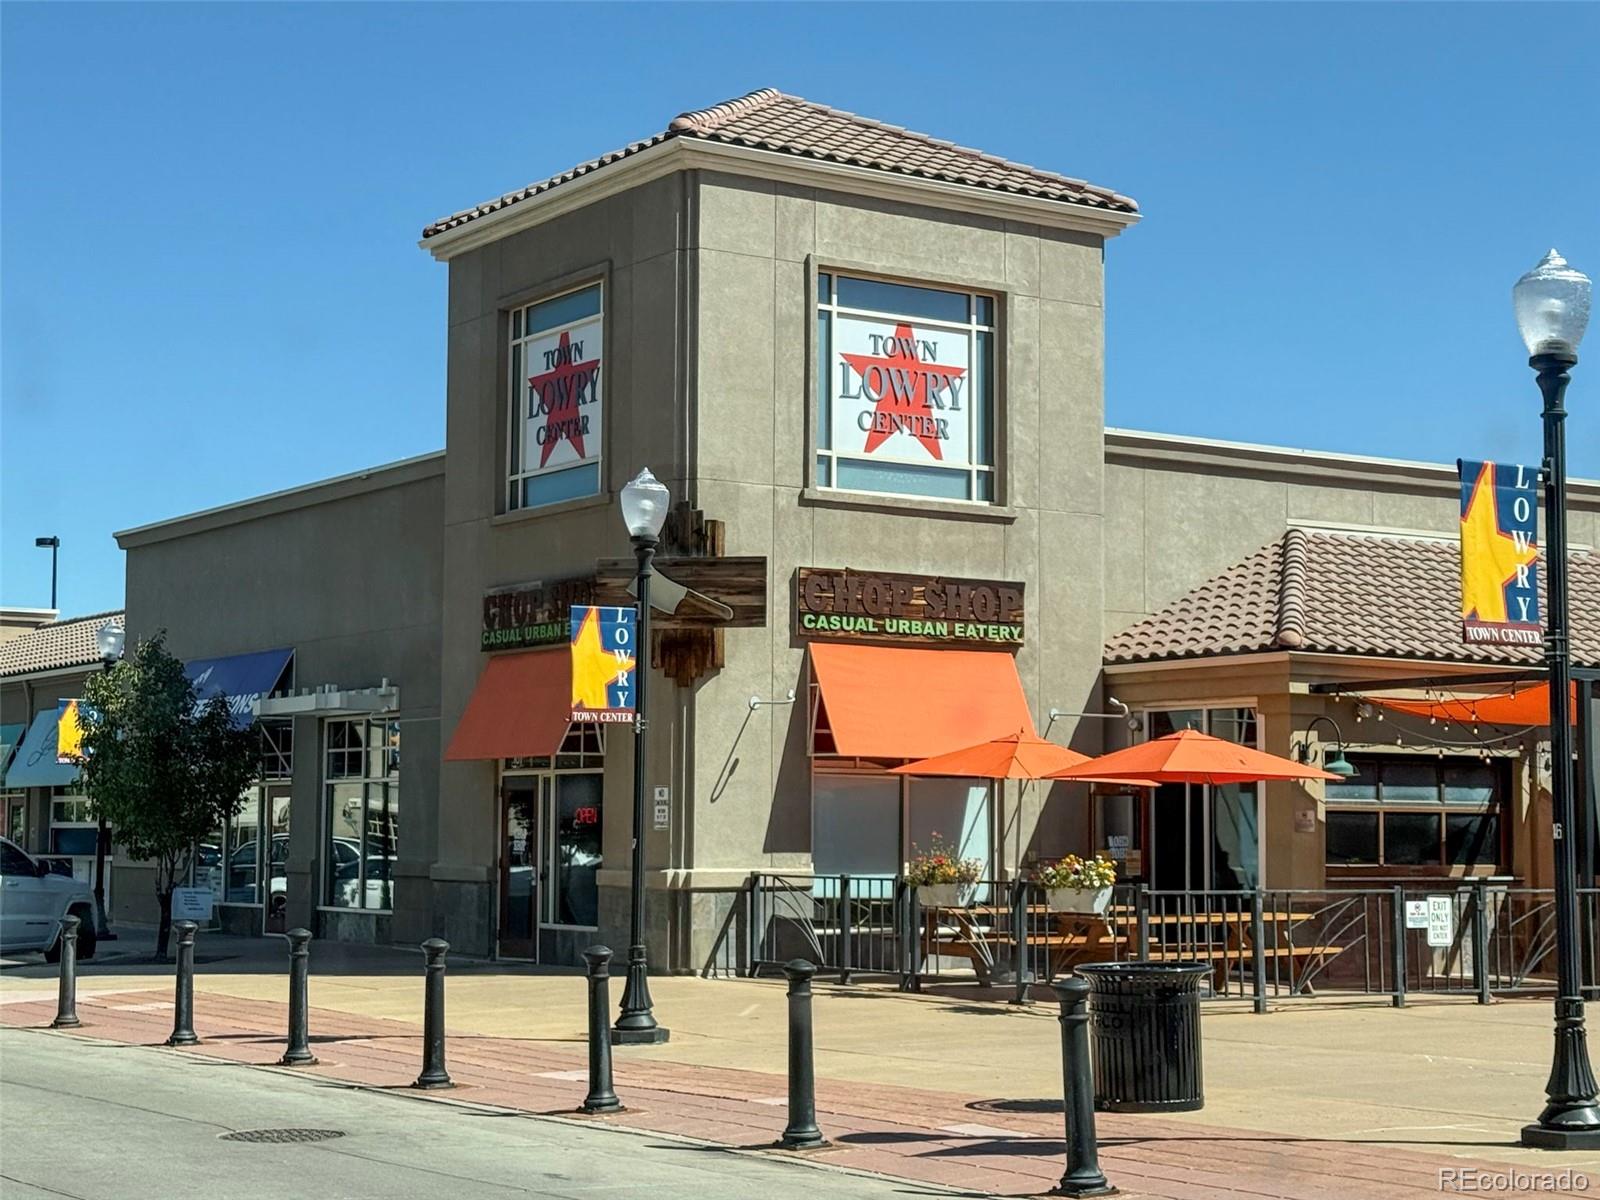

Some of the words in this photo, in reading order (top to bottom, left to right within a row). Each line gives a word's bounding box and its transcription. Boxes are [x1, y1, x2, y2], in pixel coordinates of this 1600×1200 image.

[543, 341, 585, 371] TOWN
[869, 334, 938, 363] TOWN
[527, 367, 600, 420] LOWRY
[838, 362, 966, 411] LOWRY
[536, 415, 590, 446] CENTER
[857, 410, 950, 440] CENTER
[1512, 464, 1532, 622] LOWRY
[483, 588, 542, 630] CHOP
[804, 574, 914, 616] CHOP
[924, 579, 1022, 622] SHOP
[482, 628, 522, 645] CASUAL
[525, 624, 561, 640] URBAN
[803, 614, 878, 633] CASUAL
[885, 618, 948, 636] URBAN
[954, 623, 1022, 640] EATERY
[1467, 626, 1499, 641] TOWN
[1501, 628, 1541, 644] CENTER
[614, 608, 631, 708] LOWRY
[573, 711, 598, 722] TOWN
[600, 712, 633, 723] CENTER
[576, 808, 597, 824] OPEN
[1431, 913, 1449, 922] ONLY
[1433, 901, 1447, 911] EXIT
